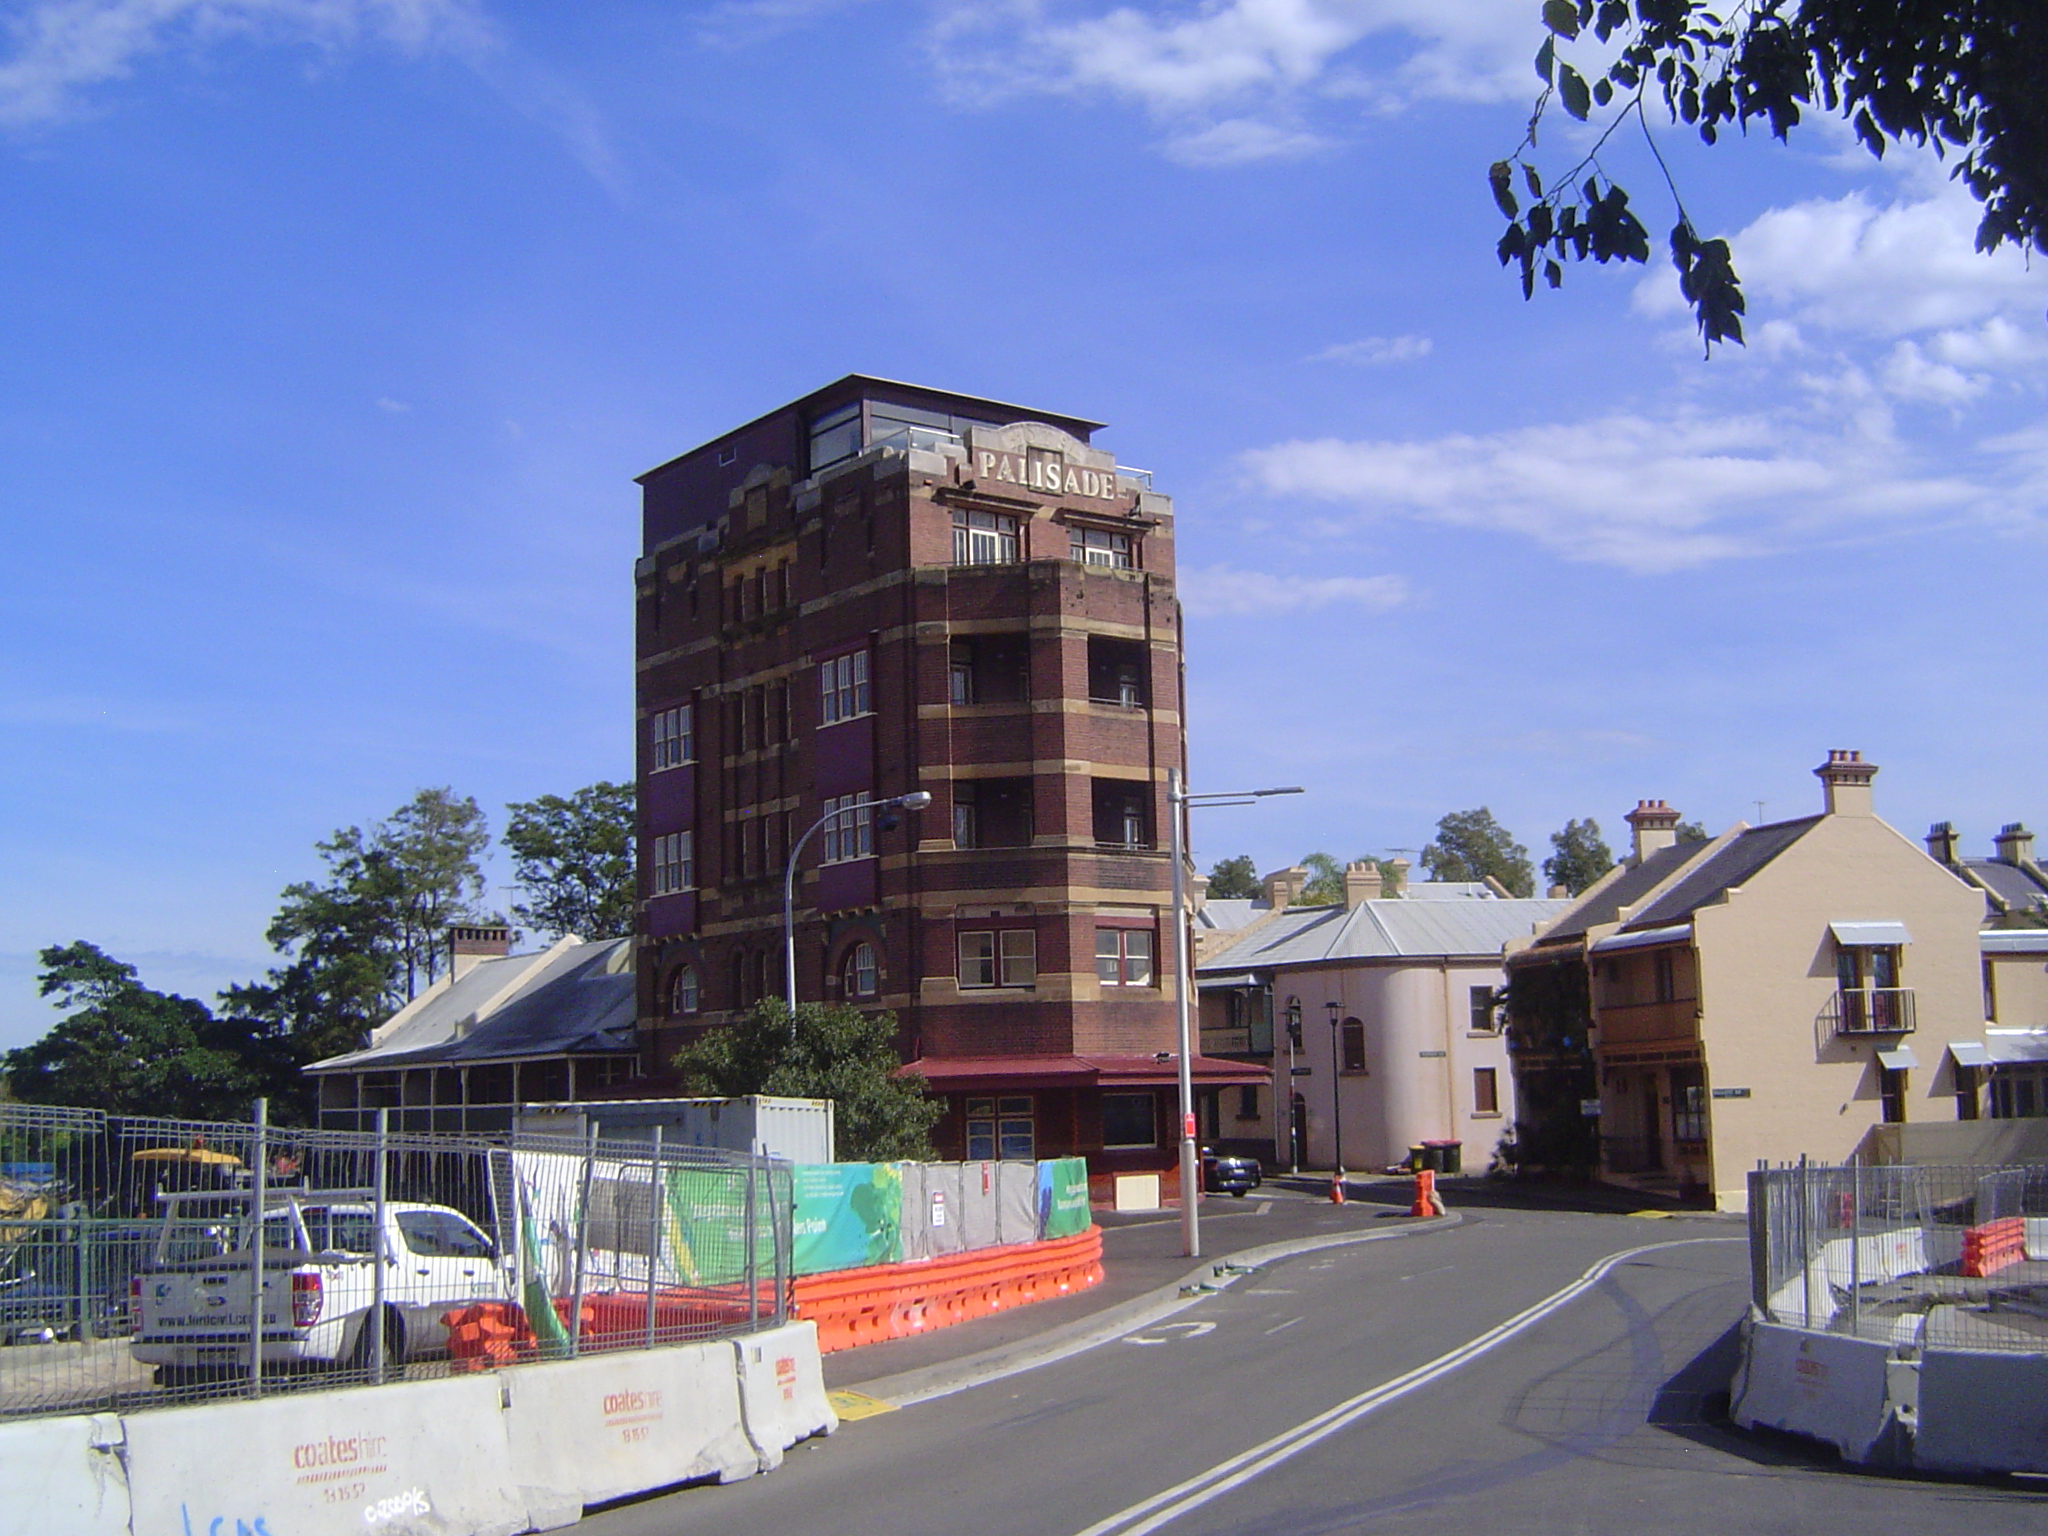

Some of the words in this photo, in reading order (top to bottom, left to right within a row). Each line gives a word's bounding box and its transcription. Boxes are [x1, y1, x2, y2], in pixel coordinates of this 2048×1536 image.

[978, 451, 1114, 500] PALISADE
[158, 1313, 277, 1327] www.fordcvl.coau
[603, 1387, 662, 1415] coatesre
